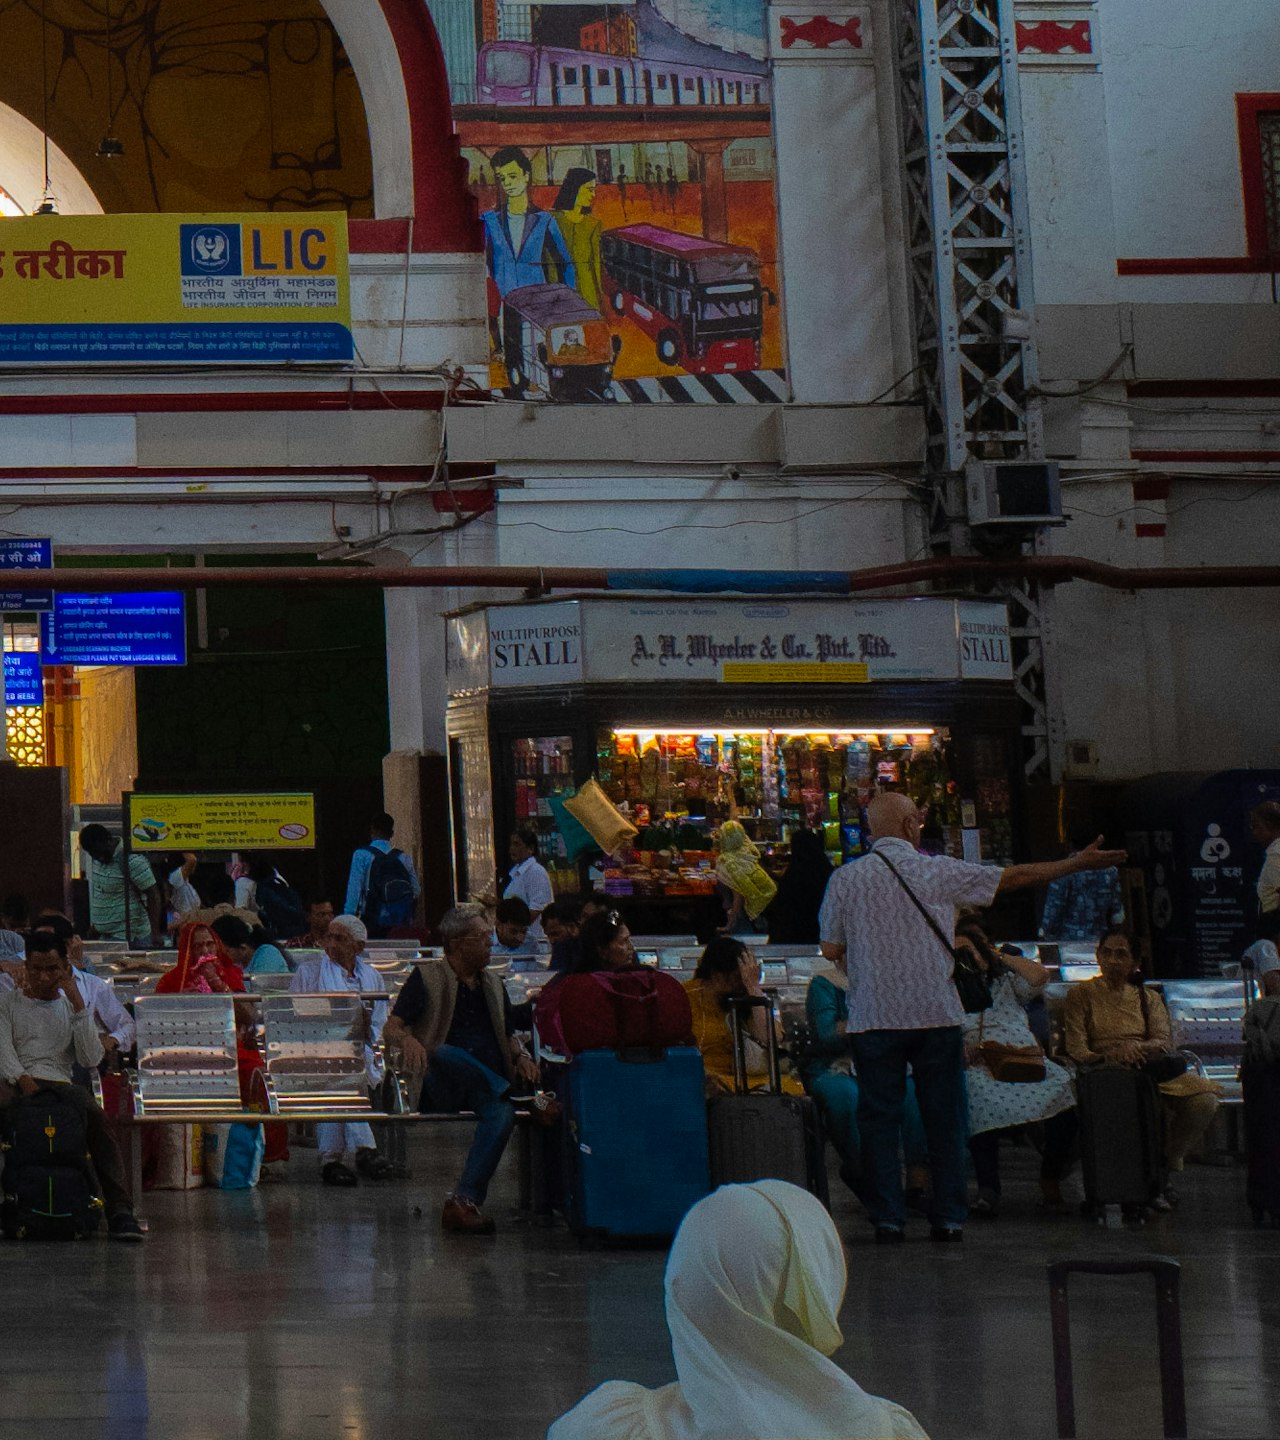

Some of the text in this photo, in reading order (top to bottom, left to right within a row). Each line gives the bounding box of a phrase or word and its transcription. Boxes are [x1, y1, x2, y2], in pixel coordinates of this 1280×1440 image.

[13, 240, 126, 279] तरीका
[252, 229, 326, 271] LIC
[182, 277, 223, 288] भारतीय
[182, 288, 336, 300] भारतीय जीवन बीमा निगम
[8, 551, 24, 563] सी
[491, 625, 580, 641] MULTIPURPOSE
[495, 641, 578, 669] STALL
[631, 633, 897, 667] A. H. Wheeler & Co. Pvt. Ltd.
[962, 637, 1009, 663] STALL
[749, 707, 802, 720] WHEELER
